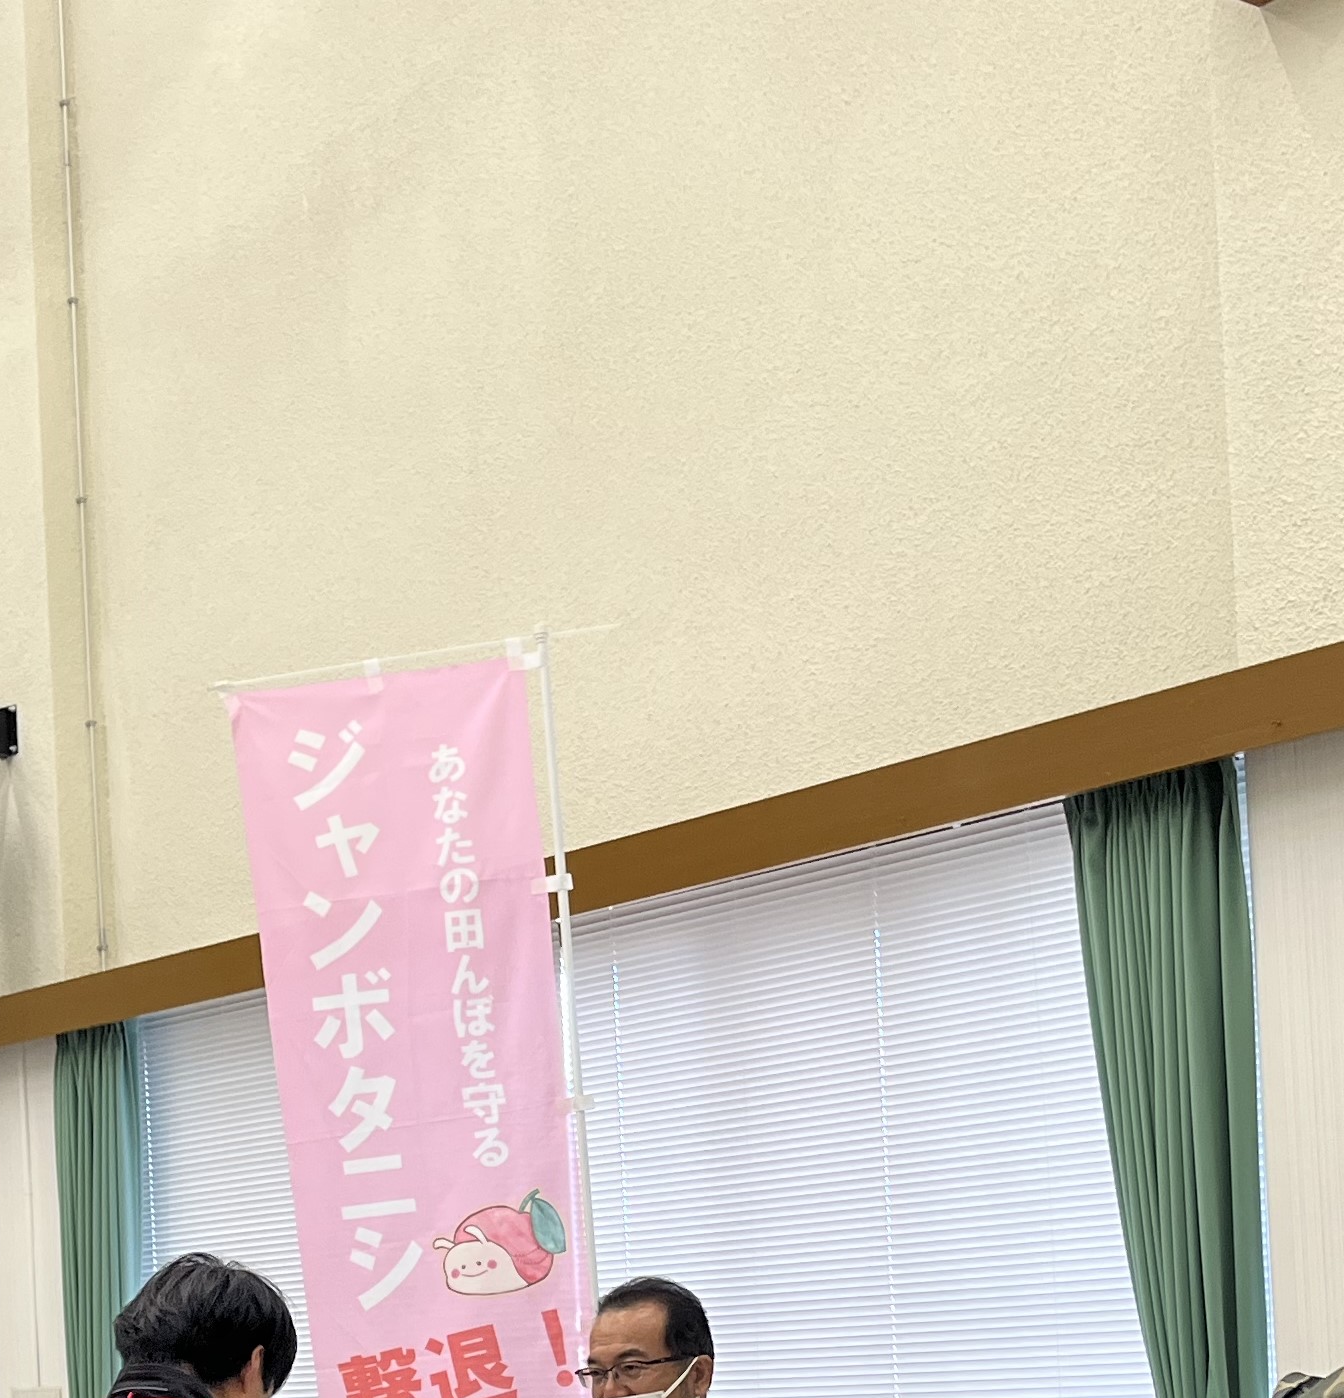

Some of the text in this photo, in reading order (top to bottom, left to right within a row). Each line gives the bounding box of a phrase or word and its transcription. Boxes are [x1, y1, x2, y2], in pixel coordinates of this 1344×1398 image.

[287, 719, 424, 1311] ジャンボタニシ
[428, 744, 509, 1167] あなたの田んぼを守る
